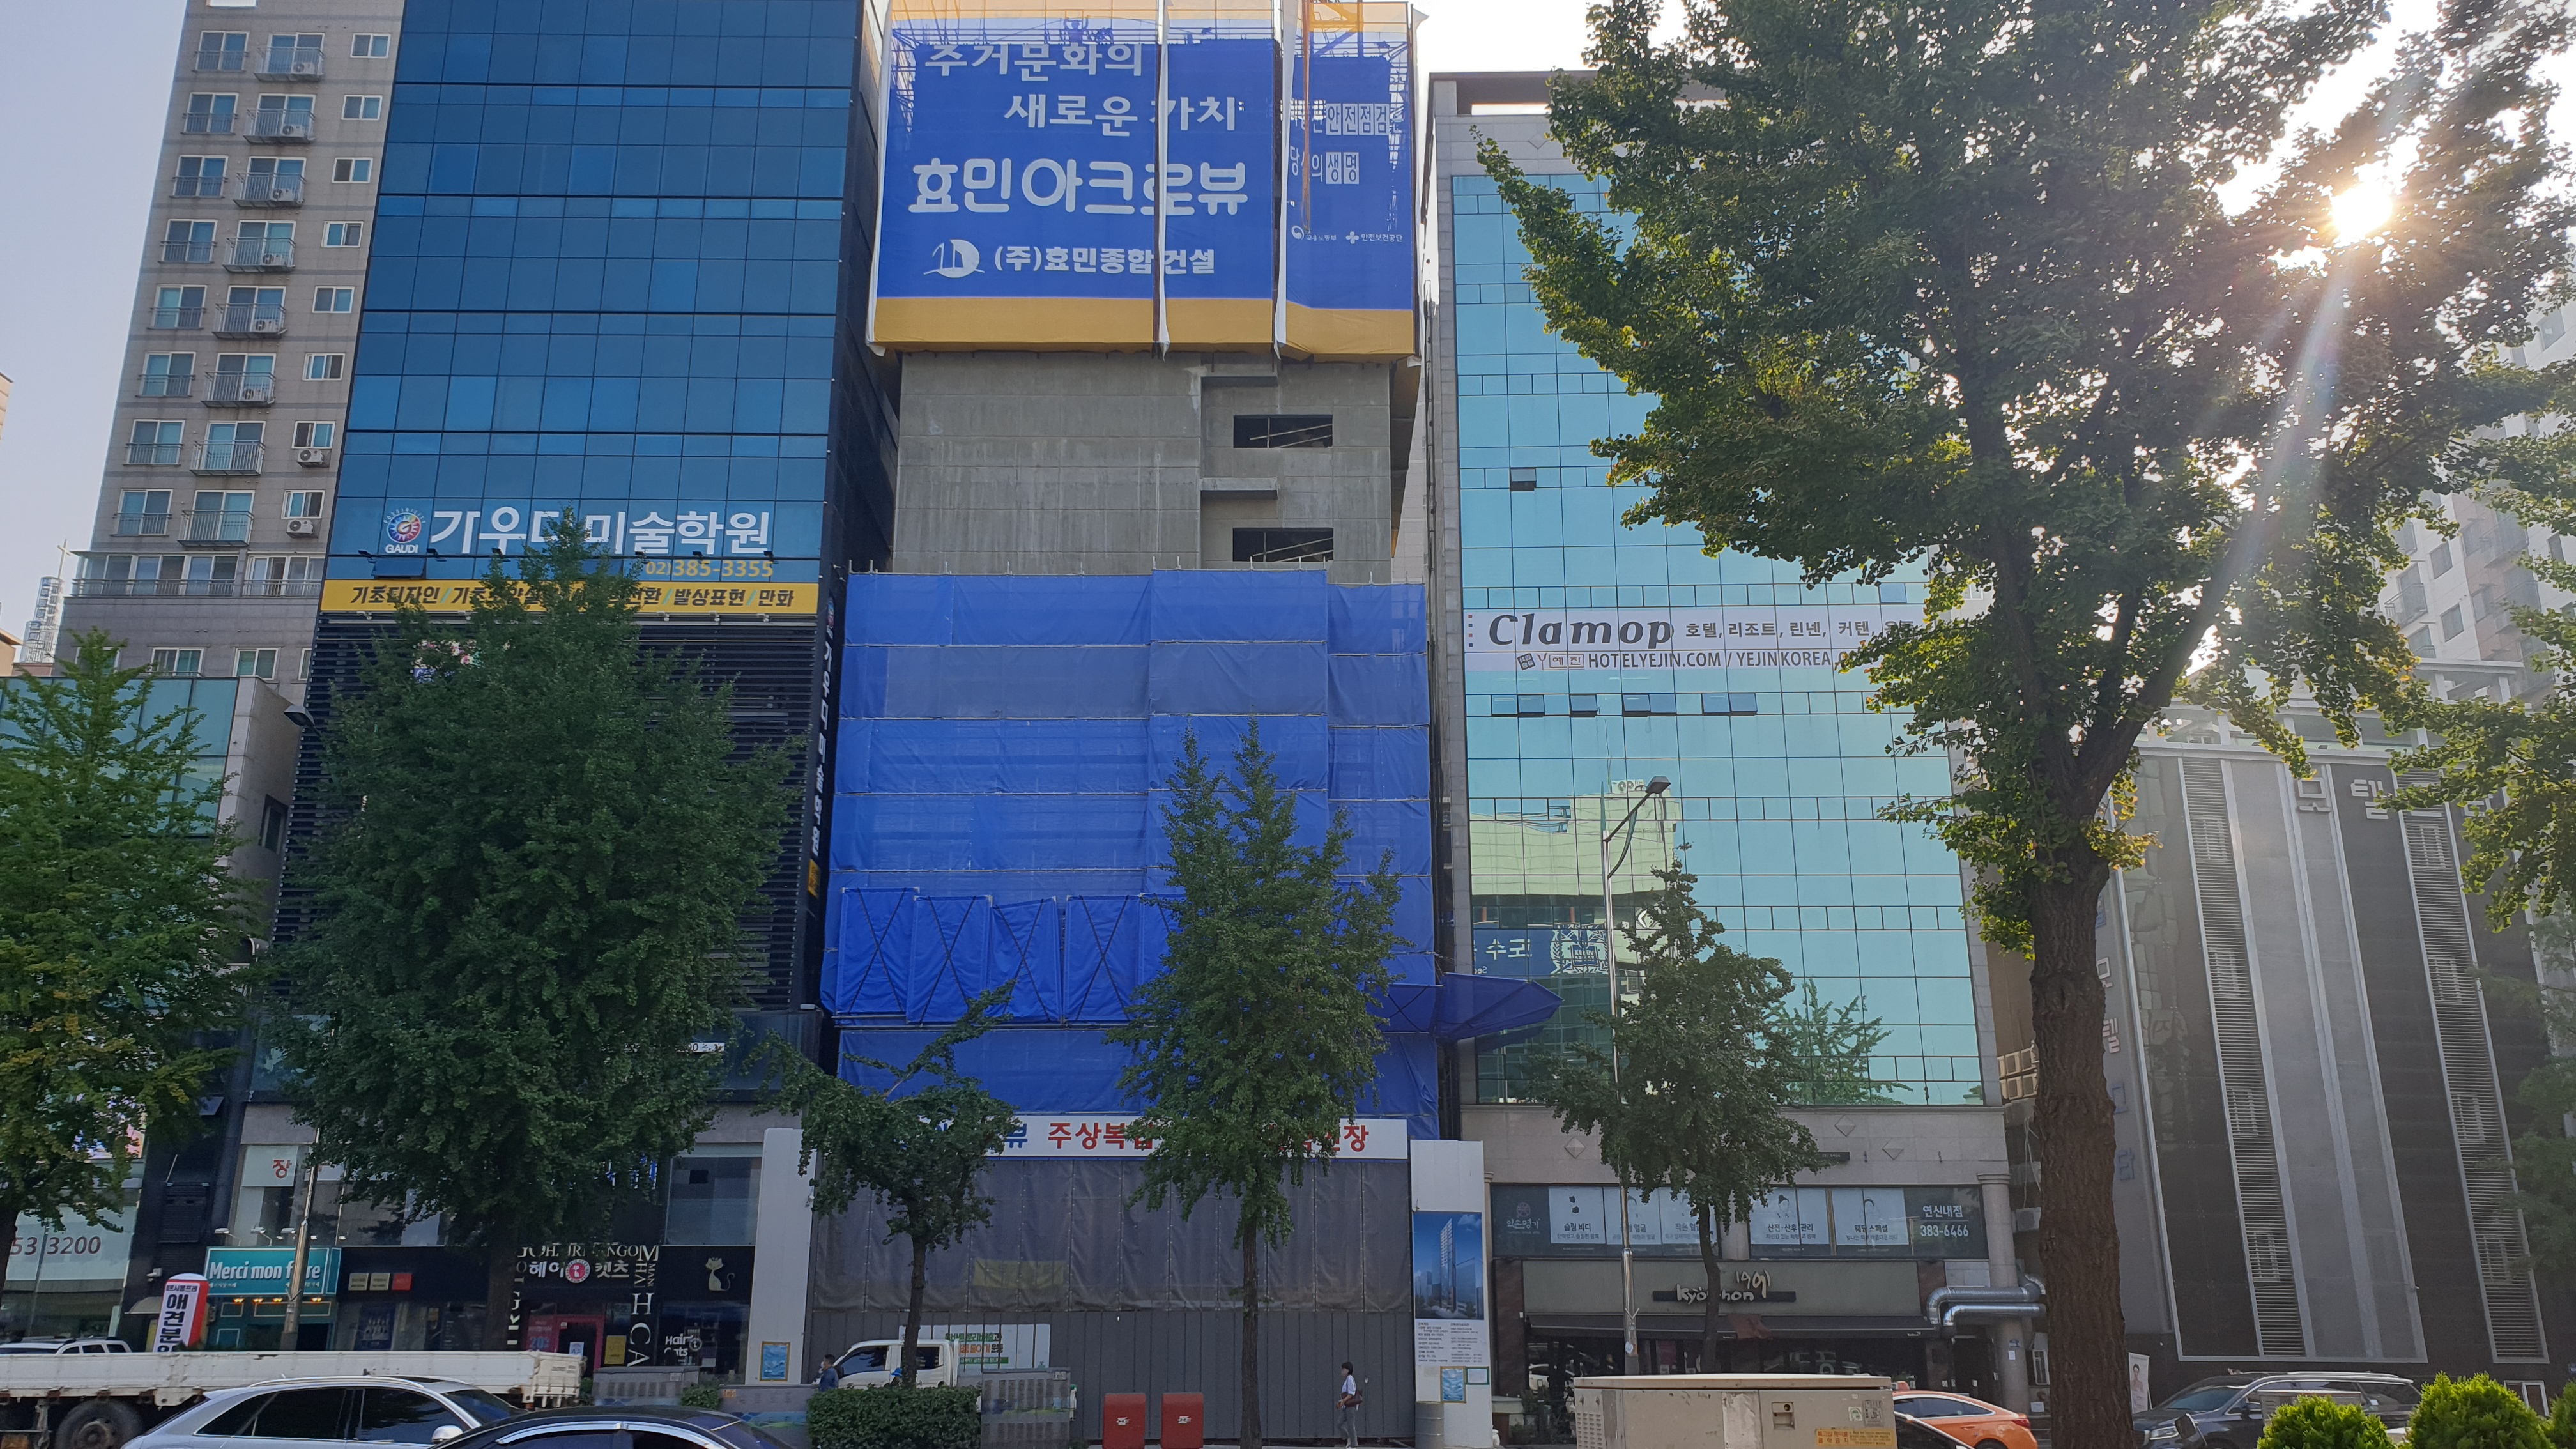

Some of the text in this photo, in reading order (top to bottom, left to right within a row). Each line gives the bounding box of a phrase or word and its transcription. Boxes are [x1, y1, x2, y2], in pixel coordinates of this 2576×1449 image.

[925, 44, 1141, 81] 주거문화의
[1004, 94, 1235, 137] 새로운 가치
[1326, 103, 1390, 135] 안전점검
[1290, 146, 1359, 184] 당의 생명
[908, 158, 1248, 215] 효민아크로뷰
[1361, 234, 1403, 242] 안전보건공단
[994, 246, 1215, 274] (주)효민종합건설
[385, 544, 418, 553] GAUDI
[645, 559, 773, 578] 02)385-3355
[351, 586, 440, 604] 기초디자인
[673, 588, 746, 606] 발상표현
[757, 590, 794, 607] 만화
[1489, 613, 1674, 649] Clamop
[1588, 652, 1721, 667] HOTELYEJIN.COM
[273, 1160, 292, 1178] 장
[1922, 1204, 1963, 1218] 연신내점
[1506, 1218, 1540, 1230] 약손명가
[1579, 1223, 1591, 1232] 바디
[1801, 1223, 1814, 1232] 관리
[1920, 1224, 1969, 1238] 383-6466
[47, 1236, 101, 1255] 3200
[210, 1259, 321, 1280] Merci mon fre
[665, 1333, 694, 1346] Hair
